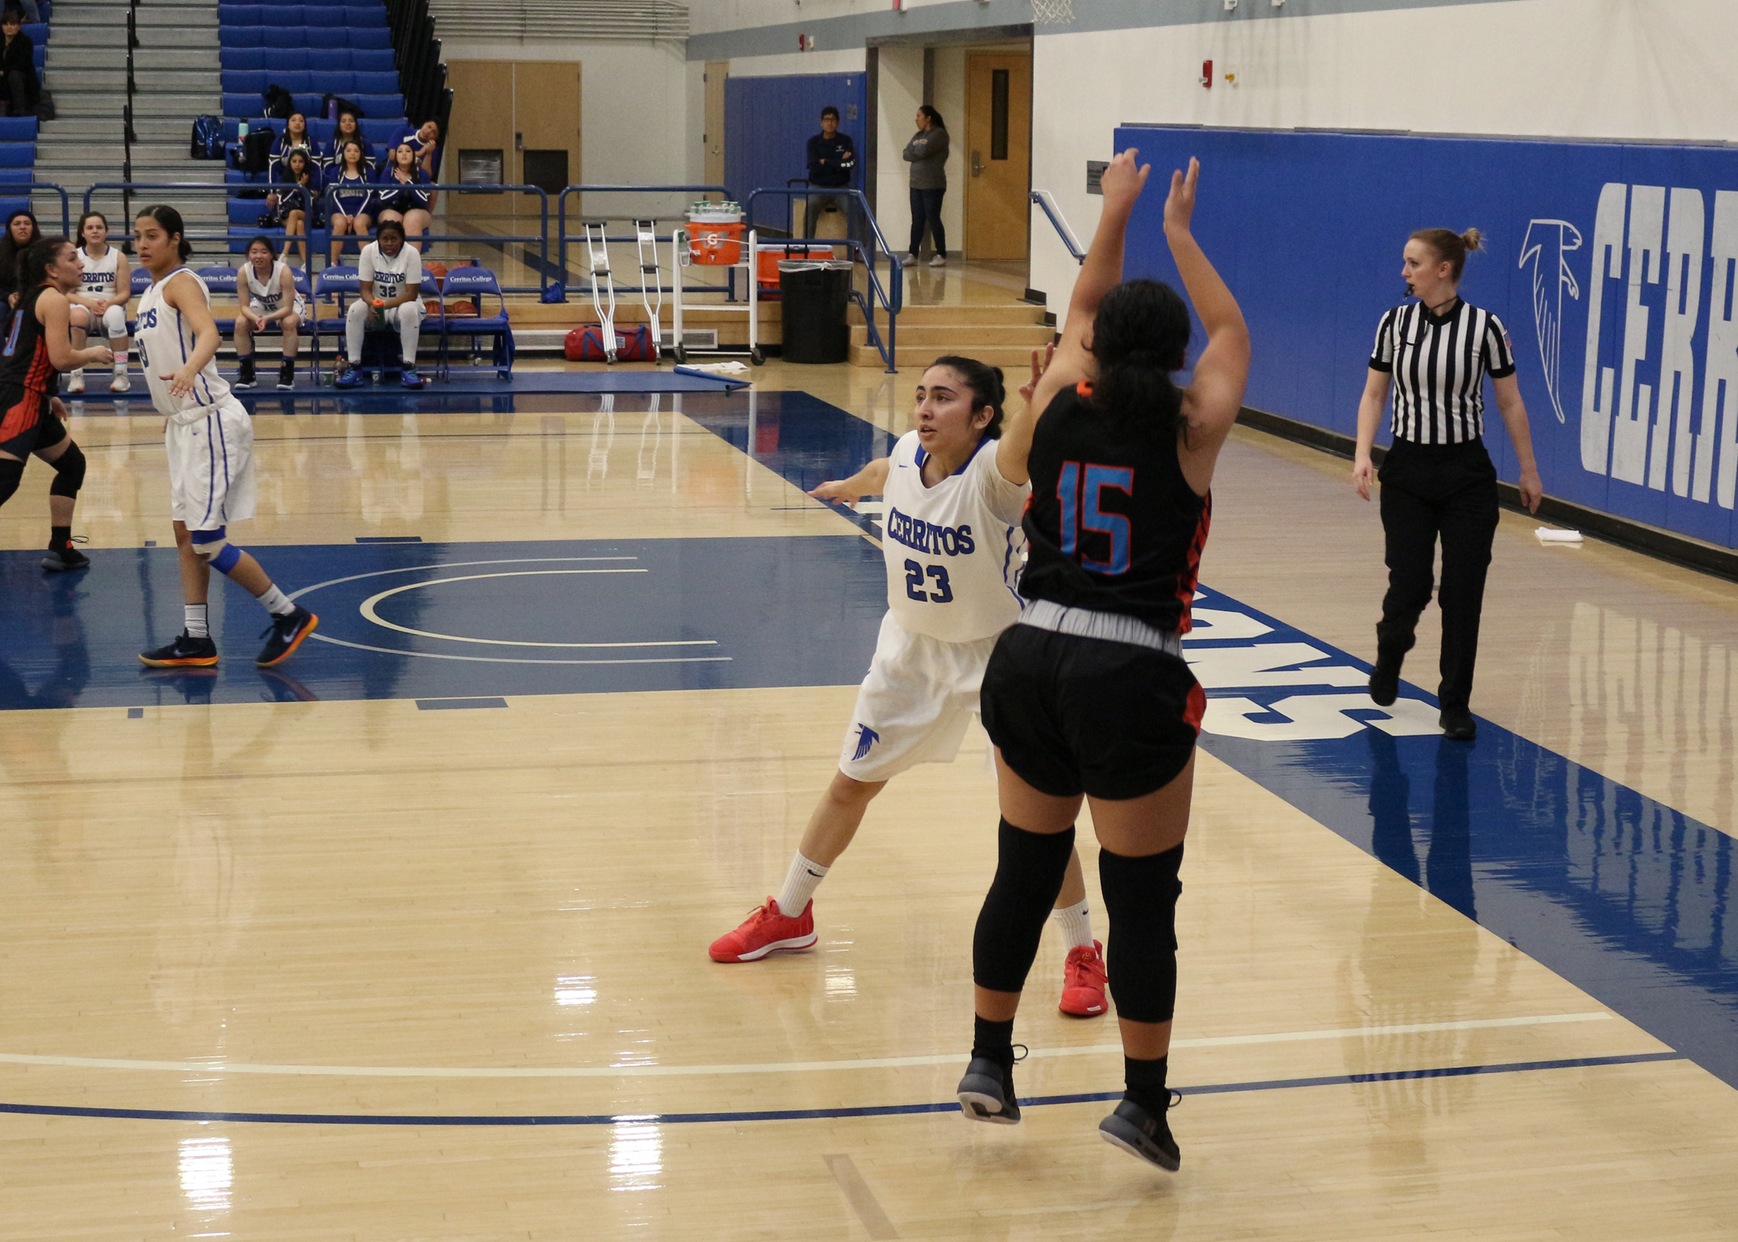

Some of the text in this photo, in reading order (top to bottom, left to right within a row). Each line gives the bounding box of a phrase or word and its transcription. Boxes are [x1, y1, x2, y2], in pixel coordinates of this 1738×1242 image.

[706, 233, 718, 245] G
[82, 272, 115, 283] ERRITOS
[379, 285, 397, 298] 32
[887, 506, 976, 557] CERRITOS
[1056, 460, 1134, 576] 15
[904, 558, 954, 604] 23
